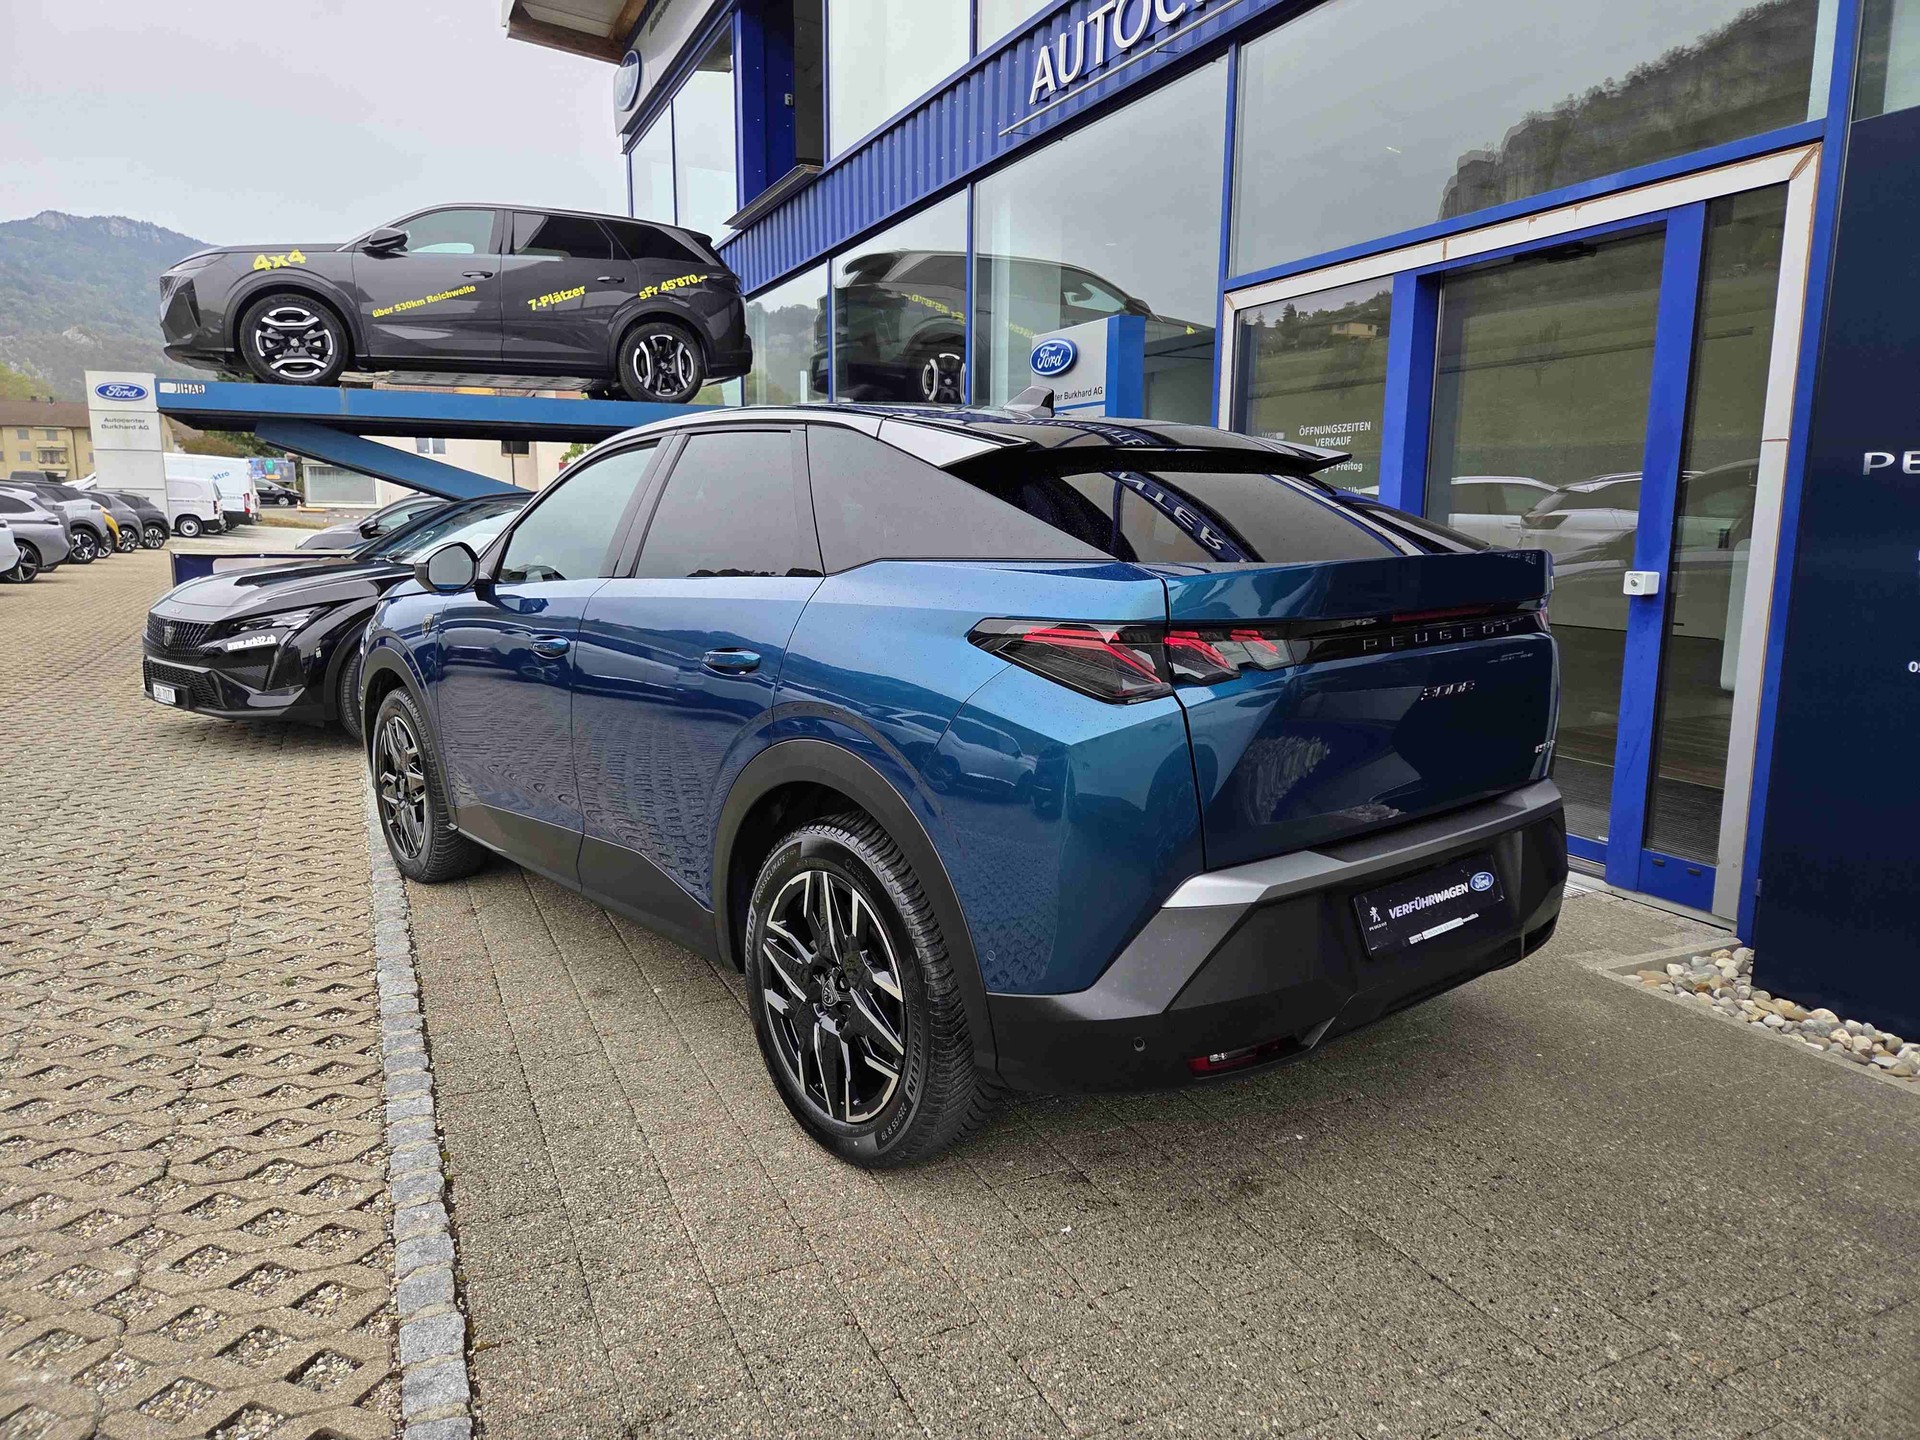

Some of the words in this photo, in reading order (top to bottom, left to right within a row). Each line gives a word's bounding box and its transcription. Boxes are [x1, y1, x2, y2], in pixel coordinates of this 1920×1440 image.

[253, 249, 306, 271] 4x4
[372, 306, 394, 318] über
[394, 298, 426, 312] 530km
[426, 285, 476, 304] Reichweite
[527, 285, 586, 311] 7-Plätzer
[638, 285, 659, 300] sFr
[1064, 388, 1092, 400] Burkhard
[1093, 386, 1103, 396] AG
[1298, 421, 1371, 437] ÖFFNUNGSZEITEN
[1315, 436, 1352, 448] VERKAUF
[1336, 462, 1363, 473] Freitag
[1363, 619, 1512, 650] PEUGEOT
[1388, 882, 1469, 920] VERFÜHRWAGEN
